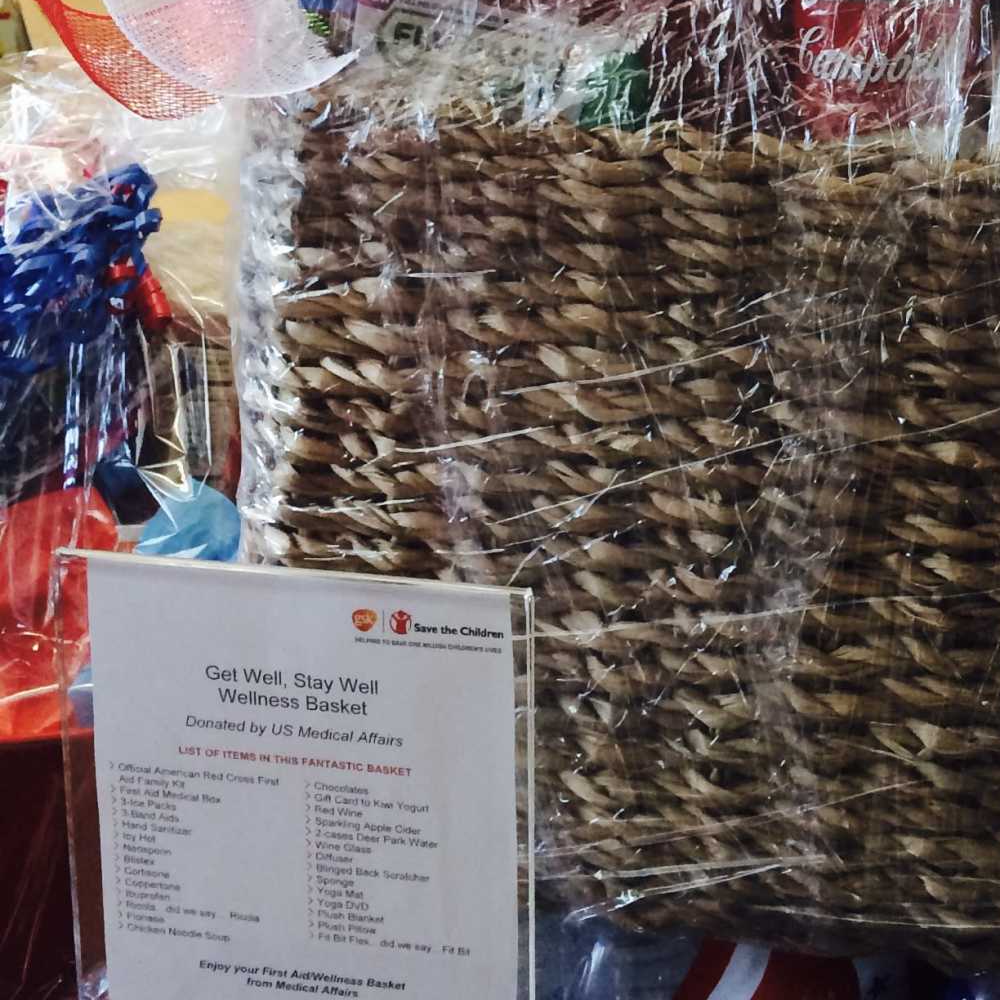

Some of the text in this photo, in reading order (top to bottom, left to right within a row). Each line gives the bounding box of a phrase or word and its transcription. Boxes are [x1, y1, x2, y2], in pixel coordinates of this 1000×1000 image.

[414, 623, 504, 639] Save the Children
[205, 665, 379, 695] Get Well, Stay Well
[218, 688, 368, 716] Wellness Basket
[185, 715, 404, 747] Donated by US Medical Affairs
[178, 746, 412, 777] LIST OF ITEMS IN THIS FANTASTIC BASKET
[118, 762, 279, 786] Official American Red Cross First
[119, 775, 185, 789] Aid Family Kit
[314, 782, 369, 795] Chocolates
[120, 786, 221, 804] First Aid Medical Box
[148, 799, 177, 811] Packs
[314, 793, 332, 803] Gift
[334, 796, 358, 806] Card
[361, 799, 371, 807] to
[396, 801, 430, 814] Yogurt
[314, 805, 363, 818] Red Wine
[122, 821, 192, 836] Hand Sanitizer
[315, 817, 421, 836] Sparkling Apple Cider
[139, 834, 156, 843] Hot
[356, 832, 380, 842] Deer
[383, 835, 406, 845] Park
[409, 838, 439, 849] Water
[315, 841, 372, 854] Wine Glass
[315, 852, 353, 863] Diffuser
[316, 863, 430, 883] Blinged Back Scratcher
[125, 878, 181, 891] Coppertone
[316, 875, 354, 888] Sponge
[318, 887, 364, 900] Yoga Mat
[318, 899, 369, 912] Yoga DVD
[318, 909, 384, 924] Plush Blanket
[127, 923, 231, 943] Chicken Noodle Soup
[318, 921, 346, 932] Plush
[199, 959, 406, 992] Enjoy your First Aid/Wellness Basket
[246, 977, 358, 998] from Medical Affairs
